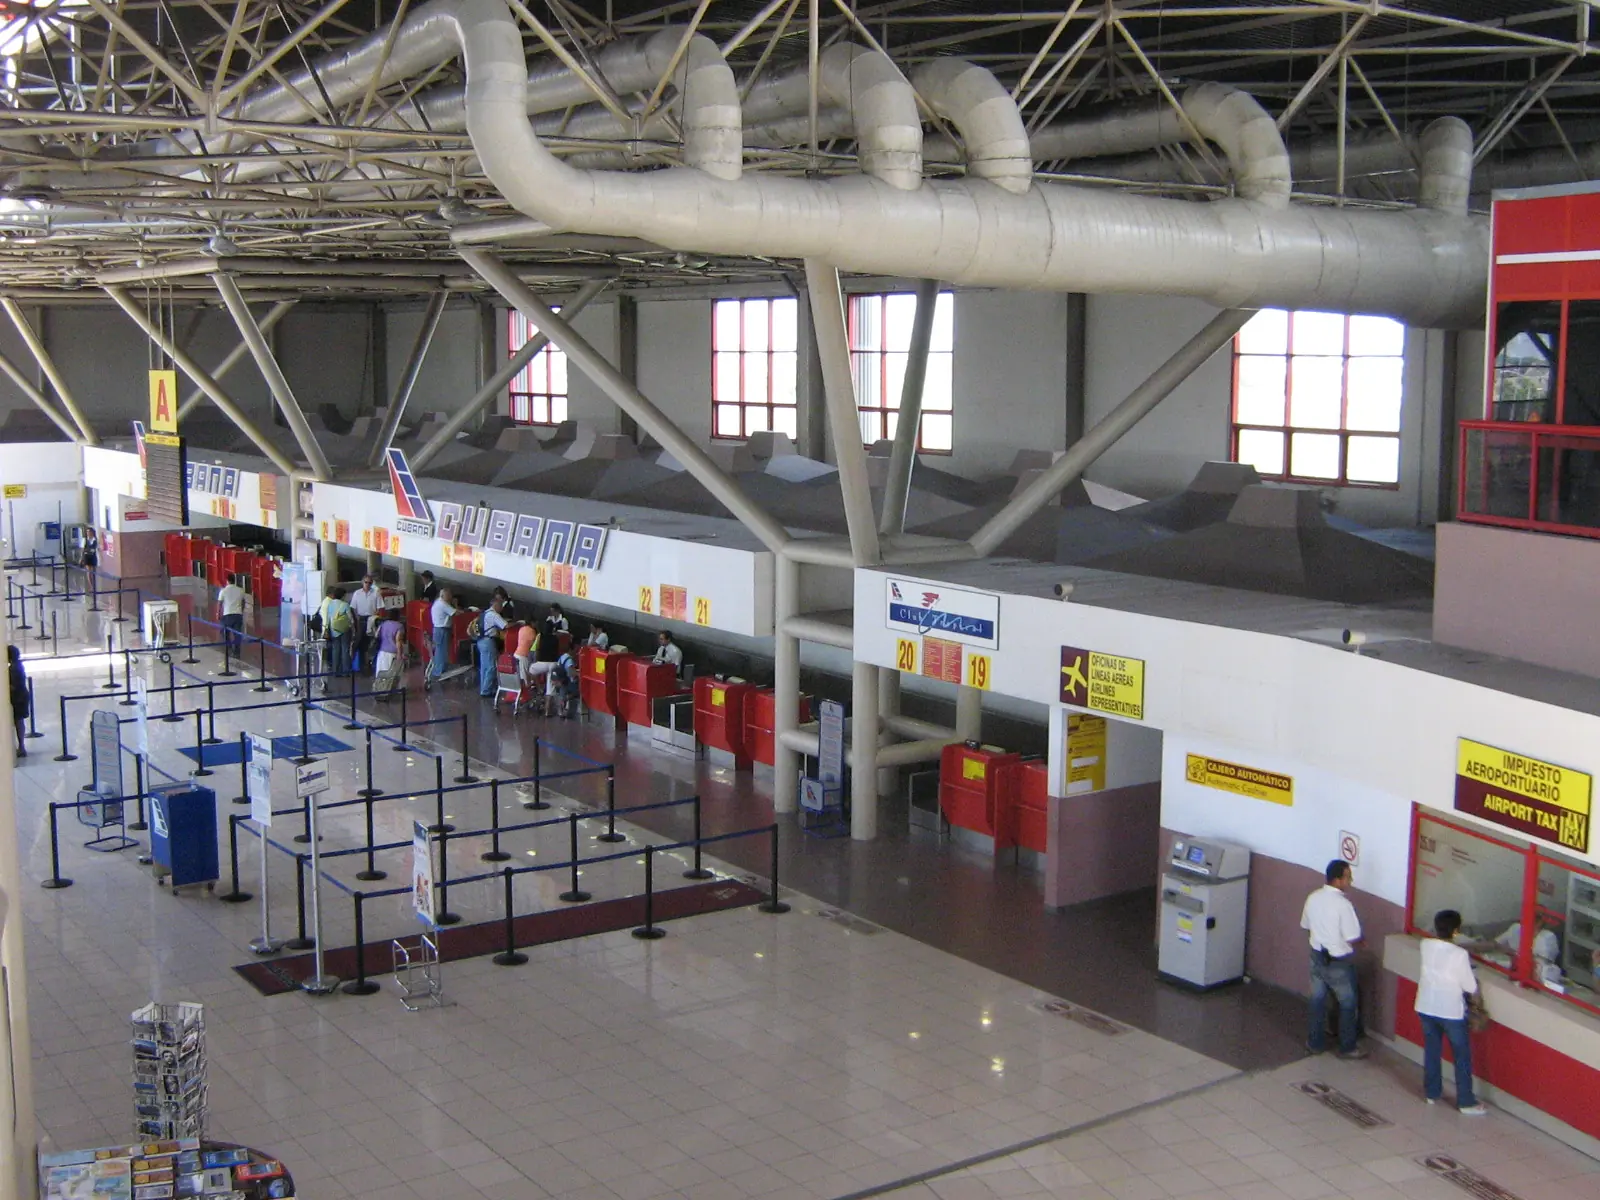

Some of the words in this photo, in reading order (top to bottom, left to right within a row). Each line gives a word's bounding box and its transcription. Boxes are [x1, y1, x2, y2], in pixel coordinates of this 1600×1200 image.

[156, 378, 170, 422] A
[396, 520, 430, 536] CUBANA
[437, 501, 607, 571] CUBANA
[537, 567, 546, 588] 24
[577, 574, 587, 597] 23
[641, 587, 652, 612] 22
[697, 599, 708, 625] 21
[899, 640, 914, 671] 20
[1091, 654, 1117, 671] OFICINAS
[1118, 659, 1126, 672] DE
[971, 656, 986, 687] 19
[1091, 667, 1111, 683] LINEAS
[1111, 672, 1134, 688] AEREAS
[1090, 682, 1115, 698] AIRLINES
[1090, 695, 1141, 717] REPRESENTATIVES
[1207, 762, 1236, 776] CAJERO
[1465, 760, 1560, 801] AEROPORTUARIO
[1503, 754, 1561, 785] IMPUESTO
[1483, 793, 1534, 823] AIRPORT
[1535, 809, 1559, 832] TAX
